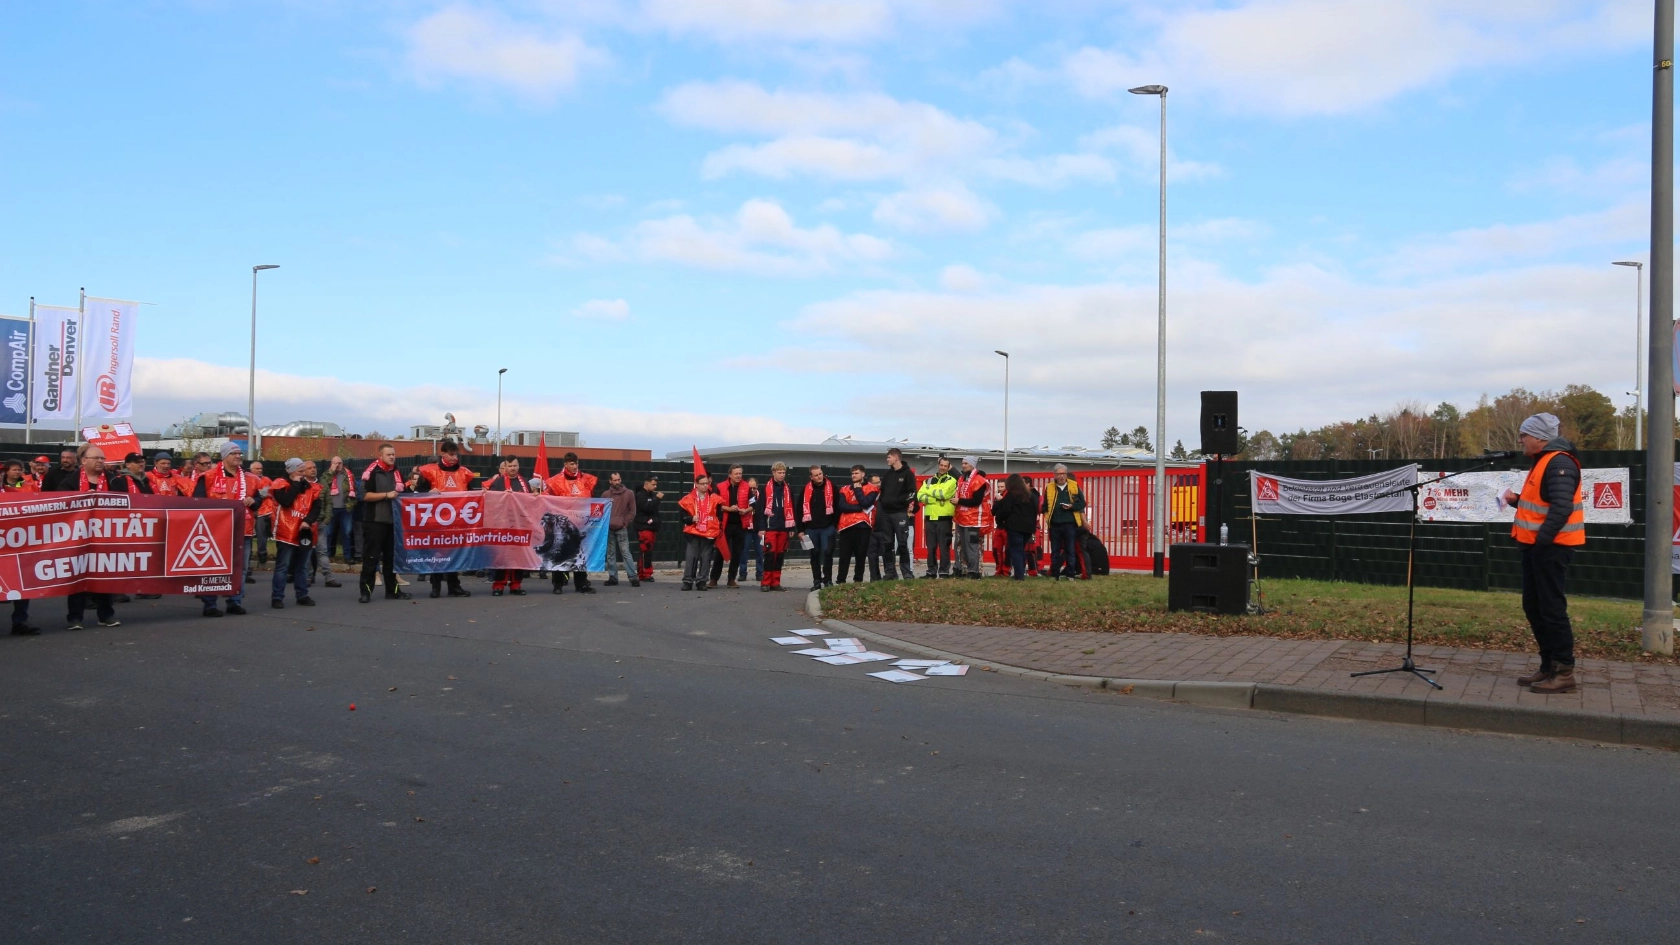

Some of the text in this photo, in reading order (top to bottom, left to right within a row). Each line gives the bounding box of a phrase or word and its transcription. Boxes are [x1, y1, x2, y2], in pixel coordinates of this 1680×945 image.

[62, 318, 77, 376] Denver
[108, 309, 120, 376] Ingersoll Rand
[6, 330, 28, 391] CompAir
[43, 344, 60, 412] Gardner
[1330, 494, 1352, 503] Boge
[1444, 488, 1469, 496] MEHR
[22, 502, 68, 514] SIMMERN.
[70, 498, 96, 508] AKTIV
[98, 498, 128, 506] DABEI!
[0, 513, 158, 549] SOLIDARITÄT
[406, 532, 530, 546] sind nicht übertrieben!
[34, 552, 152, 581] GEWINNT
[184, 584, 232, 593] Bad Kreuznach
[201, 576, 232, 584] IG METALL
